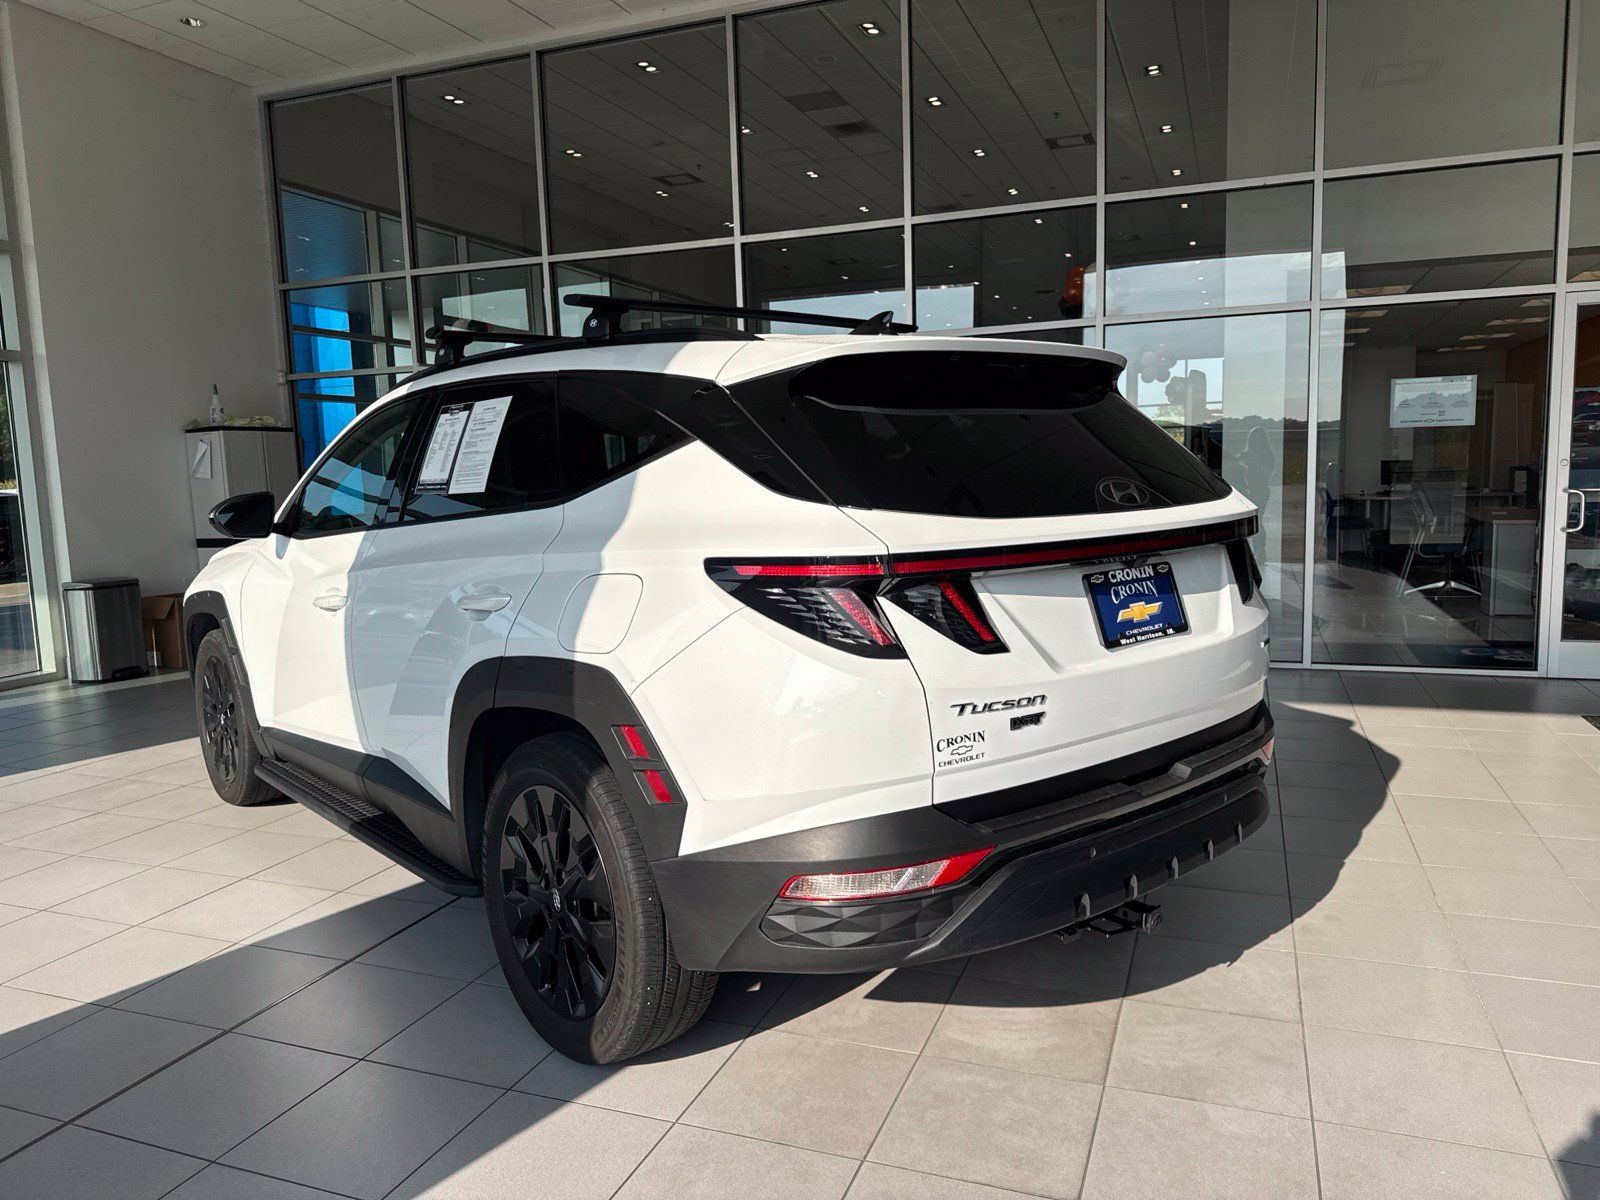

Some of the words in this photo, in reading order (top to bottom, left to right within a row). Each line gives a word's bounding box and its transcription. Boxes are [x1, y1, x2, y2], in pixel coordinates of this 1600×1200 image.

[1108, 565, 1154, 583] CRONIN
[1111, 580, 1159, 604] CRONIN
[1126, 623, 1163, 636] CHEVROLET
[1120, 637, 1136, 645] West
[936, 730, 985, 753] CRONIN
[938, 752, 986, 768] CHEVROLET
